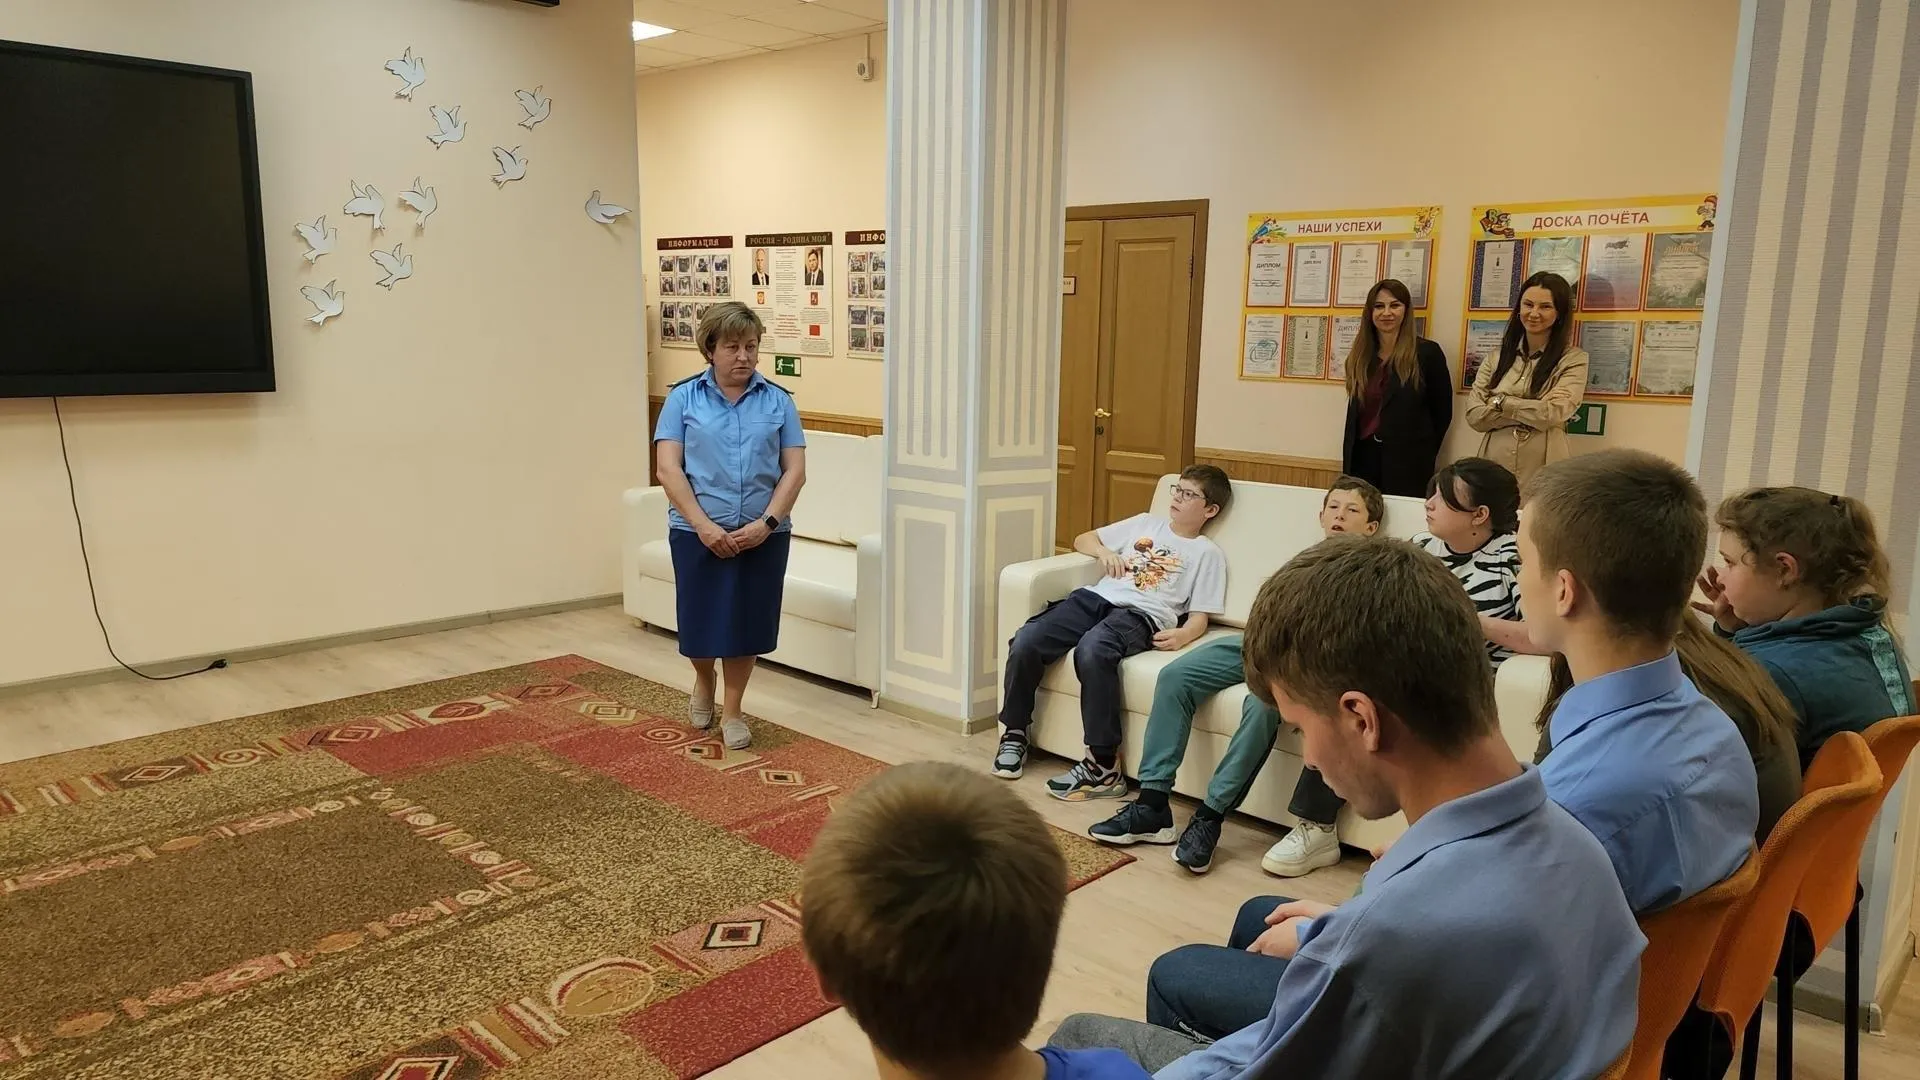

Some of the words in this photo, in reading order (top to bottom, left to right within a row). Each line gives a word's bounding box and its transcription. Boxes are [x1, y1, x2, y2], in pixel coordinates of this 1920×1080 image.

[1532, 215, 1583, 230] ДОСКА
[1587, 212, 1650, 226] ПОЧЁТА
[1298, 223, 1332, 234] НАШИ
[1335, 221, 1383, 233] УСПЕХИ
[668, 239, 720, 248] ИНФОРМАЦИЯ
[750, 237, 776, 245] РОССИЯ
[782, 235, 810, 245] РОДИНА
[811, 234, 828, 243] МОЯ
